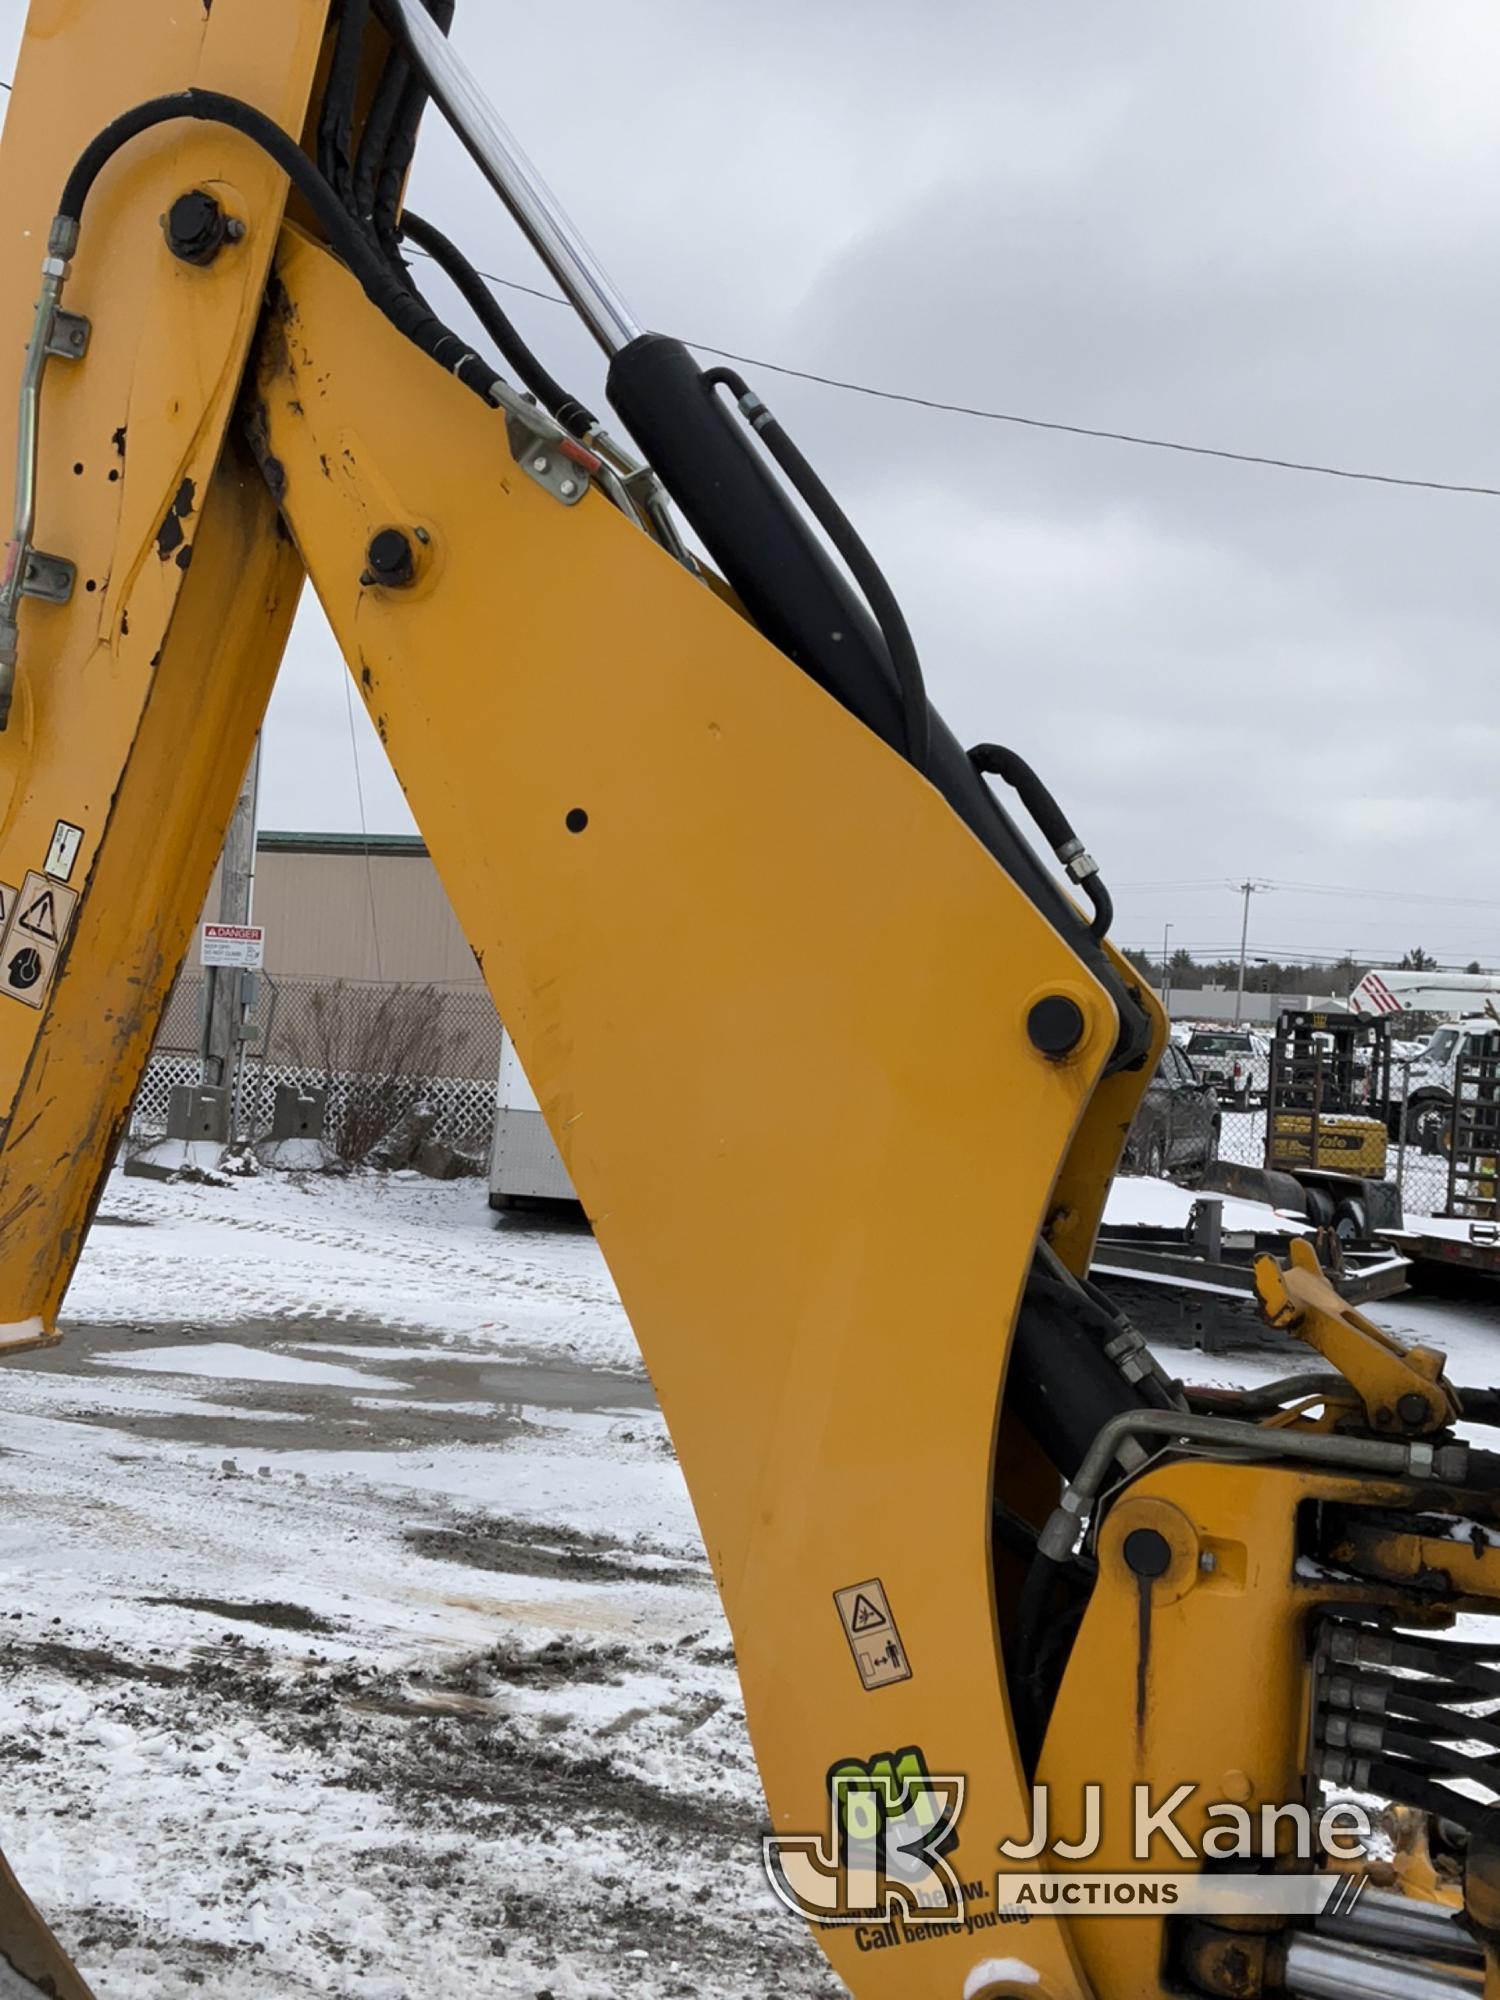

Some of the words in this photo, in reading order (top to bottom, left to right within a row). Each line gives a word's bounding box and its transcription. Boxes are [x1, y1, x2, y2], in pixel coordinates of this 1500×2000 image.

[217, 927, 259, 938] DANGER
[831, 1751, 938, 1842] 811
[855, 1921, 900, 1951] Call
[903, 1919, 962, 1945] before
[964, 1911, 998, 1935] you
